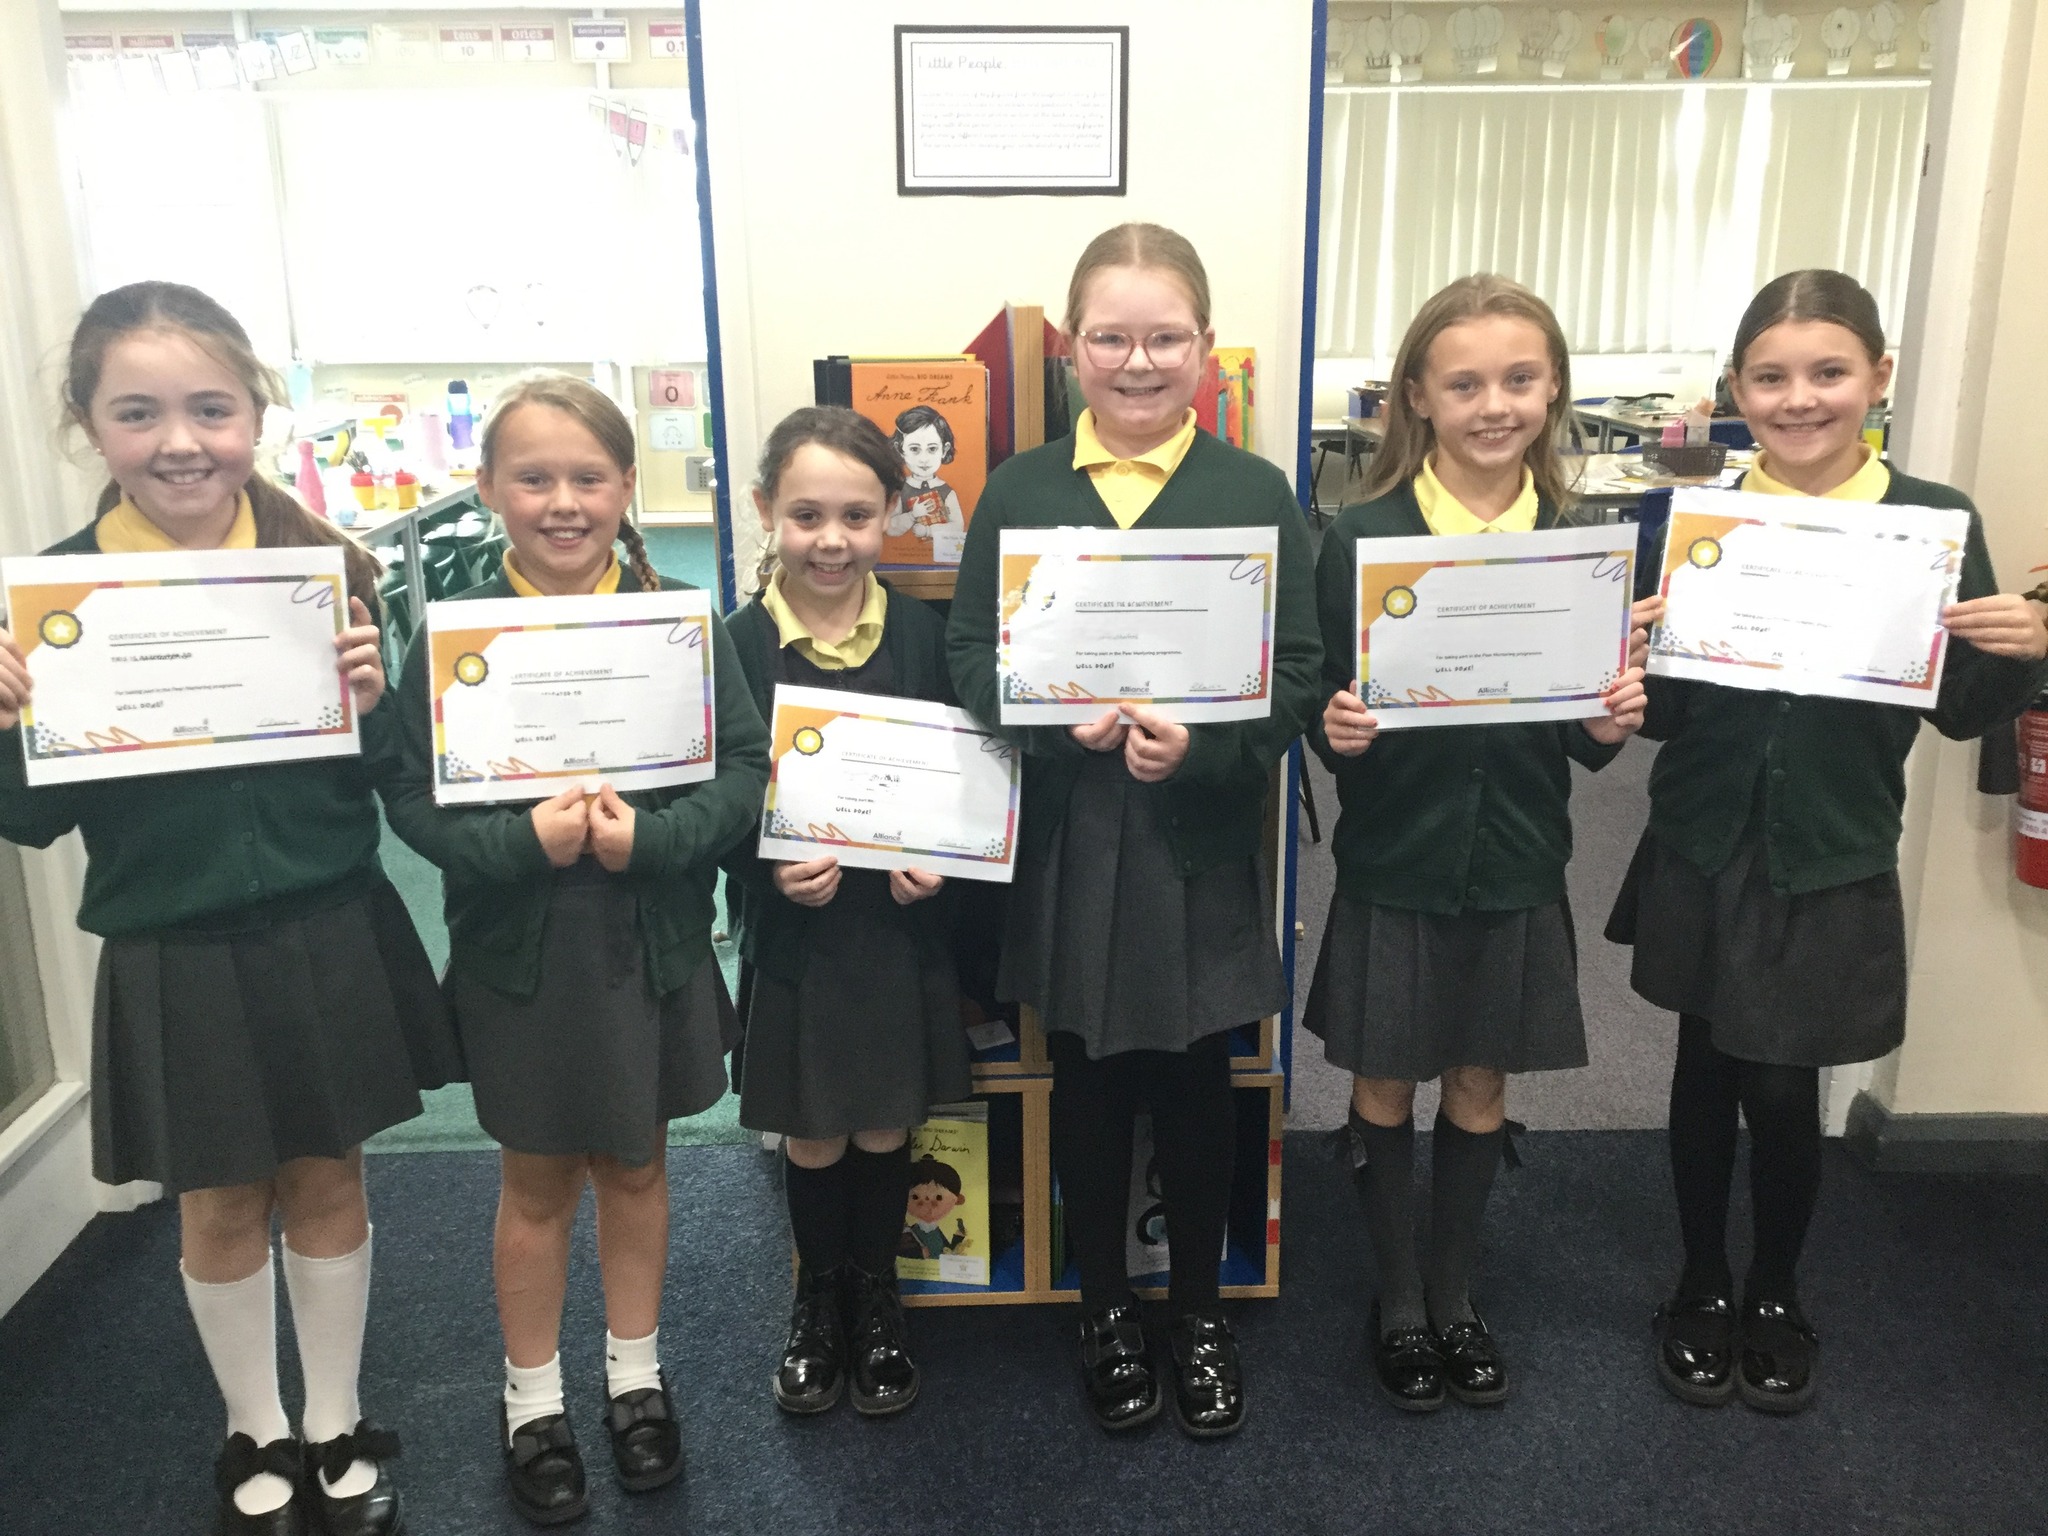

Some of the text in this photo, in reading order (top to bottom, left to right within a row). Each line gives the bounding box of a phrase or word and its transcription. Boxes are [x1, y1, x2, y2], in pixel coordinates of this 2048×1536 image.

[453, 31, 480, 41] tens
[511, 29, 543, 39] ones
[461, 46, 474, 56] 10
[524, 45, 532, 56] 1
[918, 56, 953, 69] Little
[665, 386, 679, 402] 0
[866, 381, 973, 405] Anne Frank
[1437, 605, 1477, 613] CERTIFICATE
[1489, 602, 1536, 610] ACHIEVEMENT
[108, 632, 157, 641] CERTIFICATE
[173, 628, 228, 638] ACHIEVEMENT
[565, 668, 613, 677] ACHIEVEMENT
[173, 725, 209, 735] Alliance
[563, 757, 596, 765] Alliance
[873, 832, 901, 841] Alliance
[929, 1134, 970, 1153] Darwin
